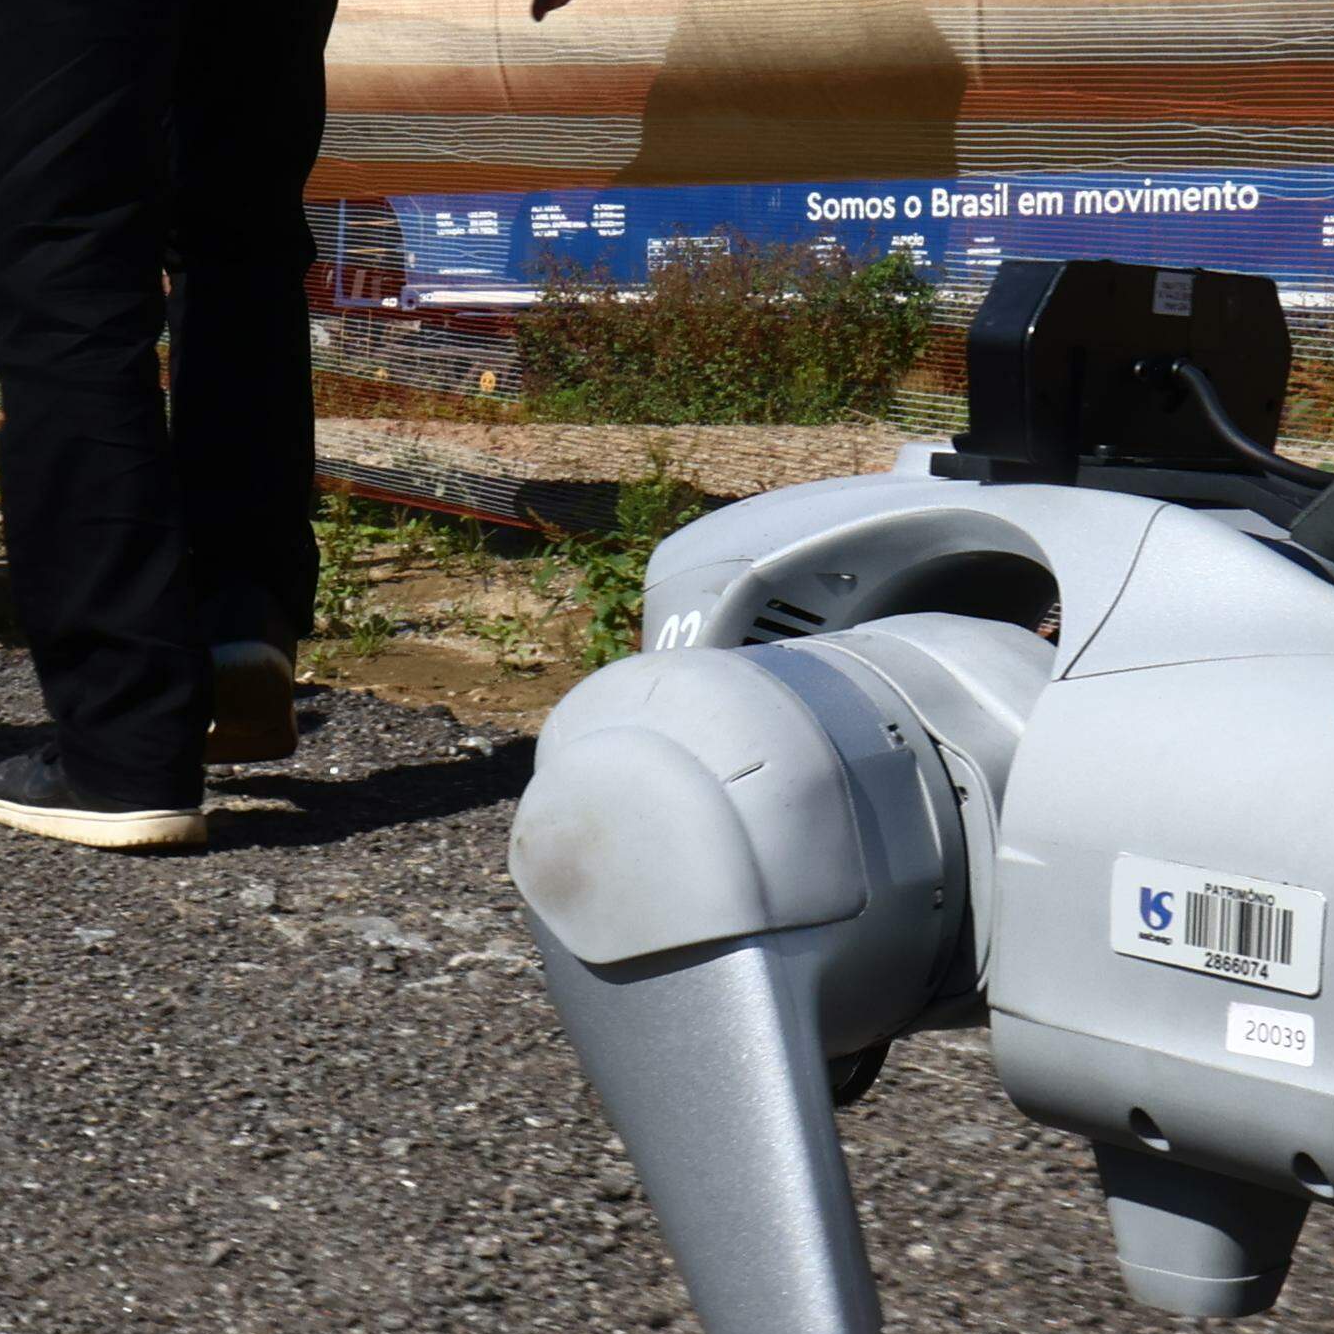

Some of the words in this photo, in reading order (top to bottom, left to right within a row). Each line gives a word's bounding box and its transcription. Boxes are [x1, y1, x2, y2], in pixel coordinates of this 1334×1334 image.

[806, 192, 895, 221] Somos
[904, 195, 922, 219] o
[931, 183, 1009, 217] Brasil
[1018, 191, 1063, 216] em
[1074, 179, 1259, 214] movimento
[1204, 882, 1275, 906] PATRIMÔNIO
[1204, 952, 1269, 979] 2866074
[1244, 1020, 1307, 1051] 20039
